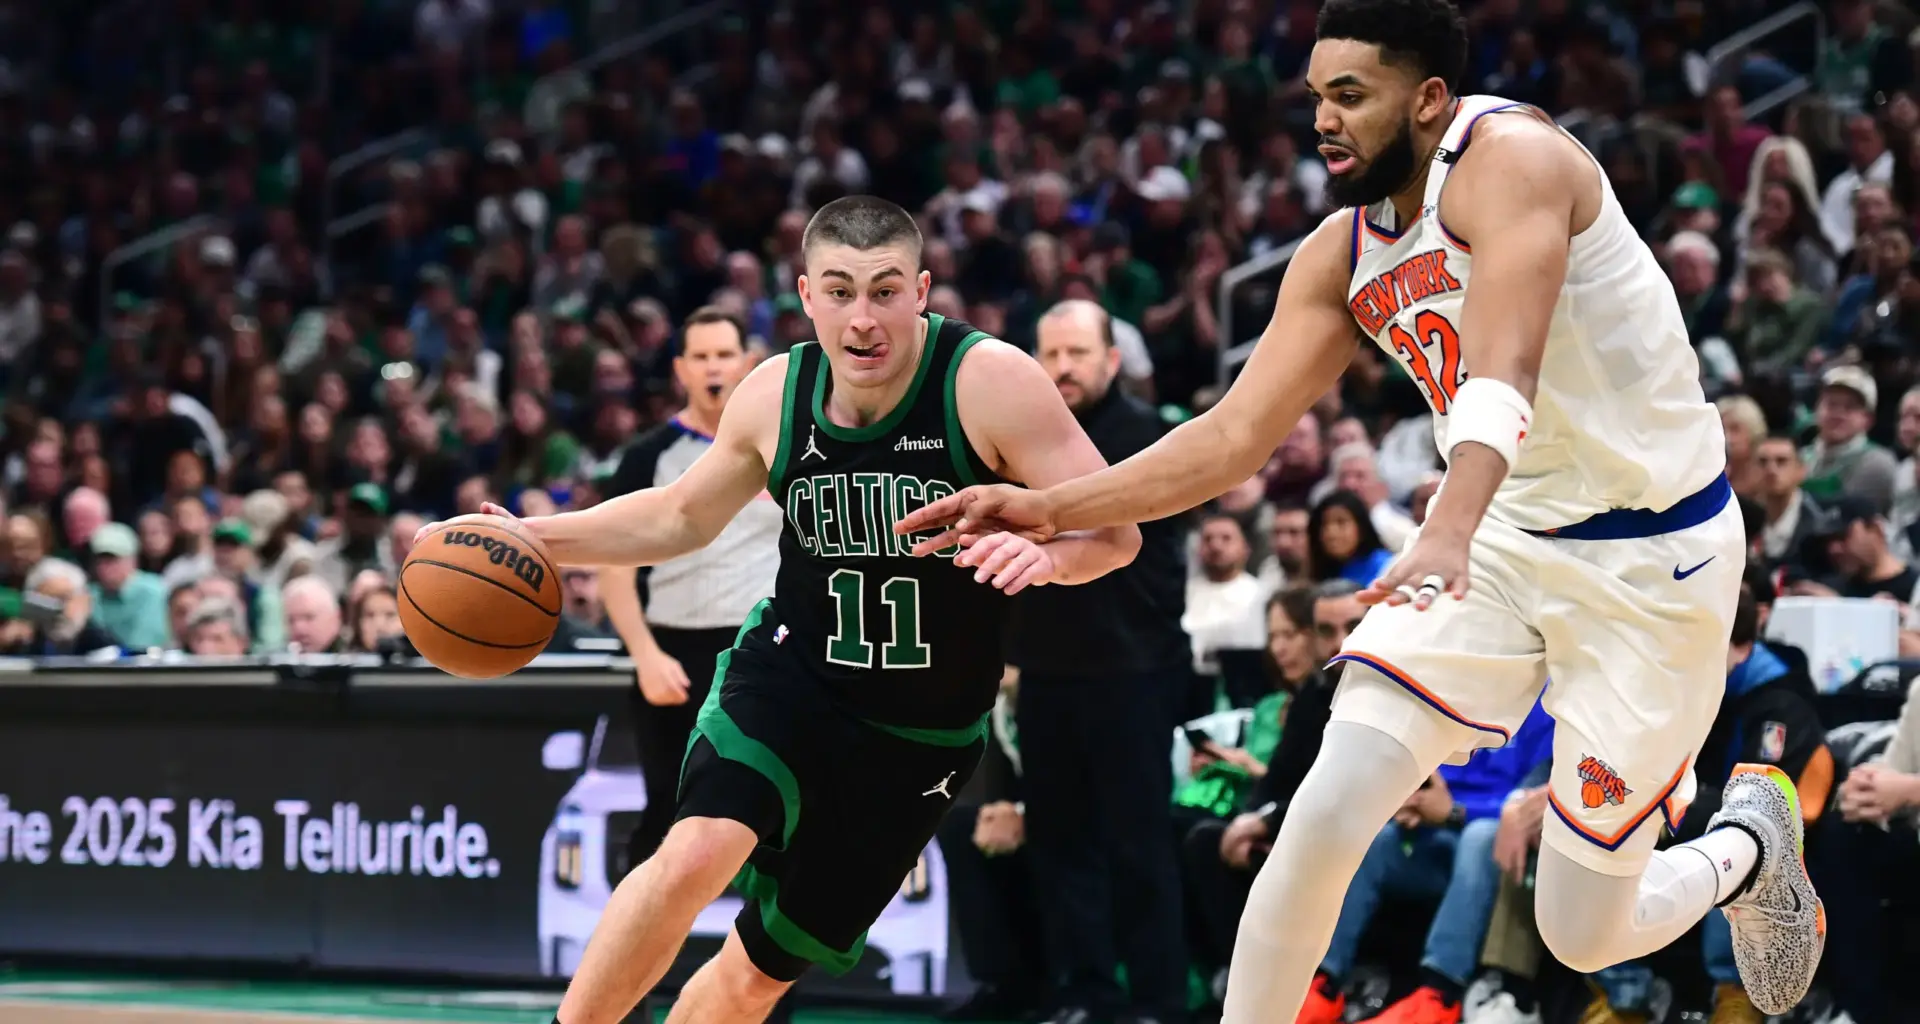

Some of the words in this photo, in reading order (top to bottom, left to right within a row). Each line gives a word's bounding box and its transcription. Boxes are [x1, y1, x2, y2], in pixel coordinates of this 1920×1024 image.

[1349, 270, 1400, 337] NEW
[1393, 248, 1463, 309] YORK
[1389, 309, 1468, 416] 32
[894, 435, 944, 451] Amica
[444, 531, 544, 593] Wilson
[826, 568, 931, 669] 11
[60, 796, 176, 867] 2025
[188, 798, 263, 870] Kia
[274, 800, 500, 878] Telluride.
